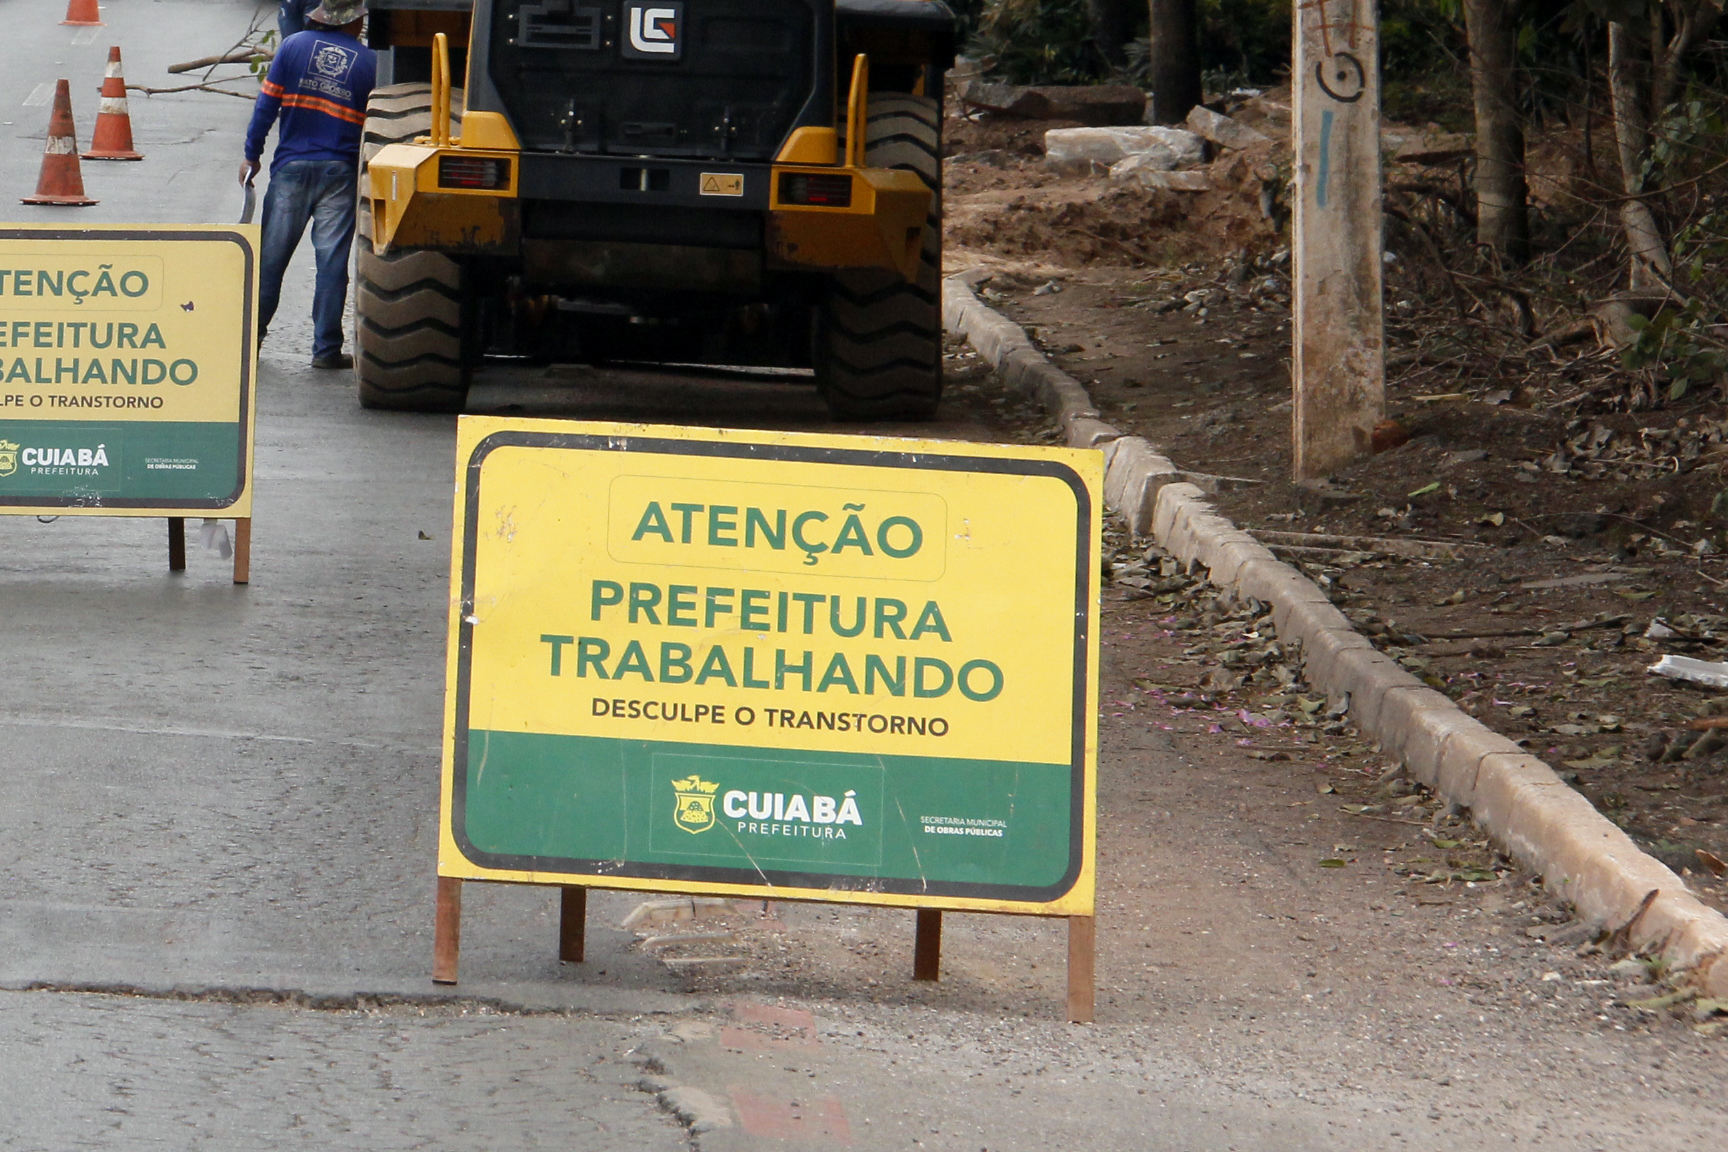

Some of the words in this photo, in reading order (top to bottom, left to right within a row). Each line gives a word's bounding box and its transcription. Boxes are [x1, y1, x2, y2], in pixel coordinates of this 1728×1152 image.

[29, 394, 43, 407] O
[48, 395, 164, 409] TRANSTORNO
[21, 444, 110, 467] CUIABÁ
[30, 467, 99, 476] PREFEITURA
[631, 501, 924, 566] ATENÇÃO
[590, 580, 953, 642] PREFEITURA
[540, 634, 1005, 703] TRABALHANDO
[592, 697, 725, 726] DESCULPE
[734, 706, 757, 727] O
[764, 707, 950, 738] TRANSTORNO
[722, 789, 863, 826] CUIABÁ
[738, 821, 847, 840] PREFEITURA
[920, 815, 966, 826] SECRETARIA
[966, 818, 1007, 828] MUNICIPAL
[924, 825, 936, 834] DE
[936, 826, 964, 835] OBRAS
[965, 827, 1003, 837] PÚBLICAS
